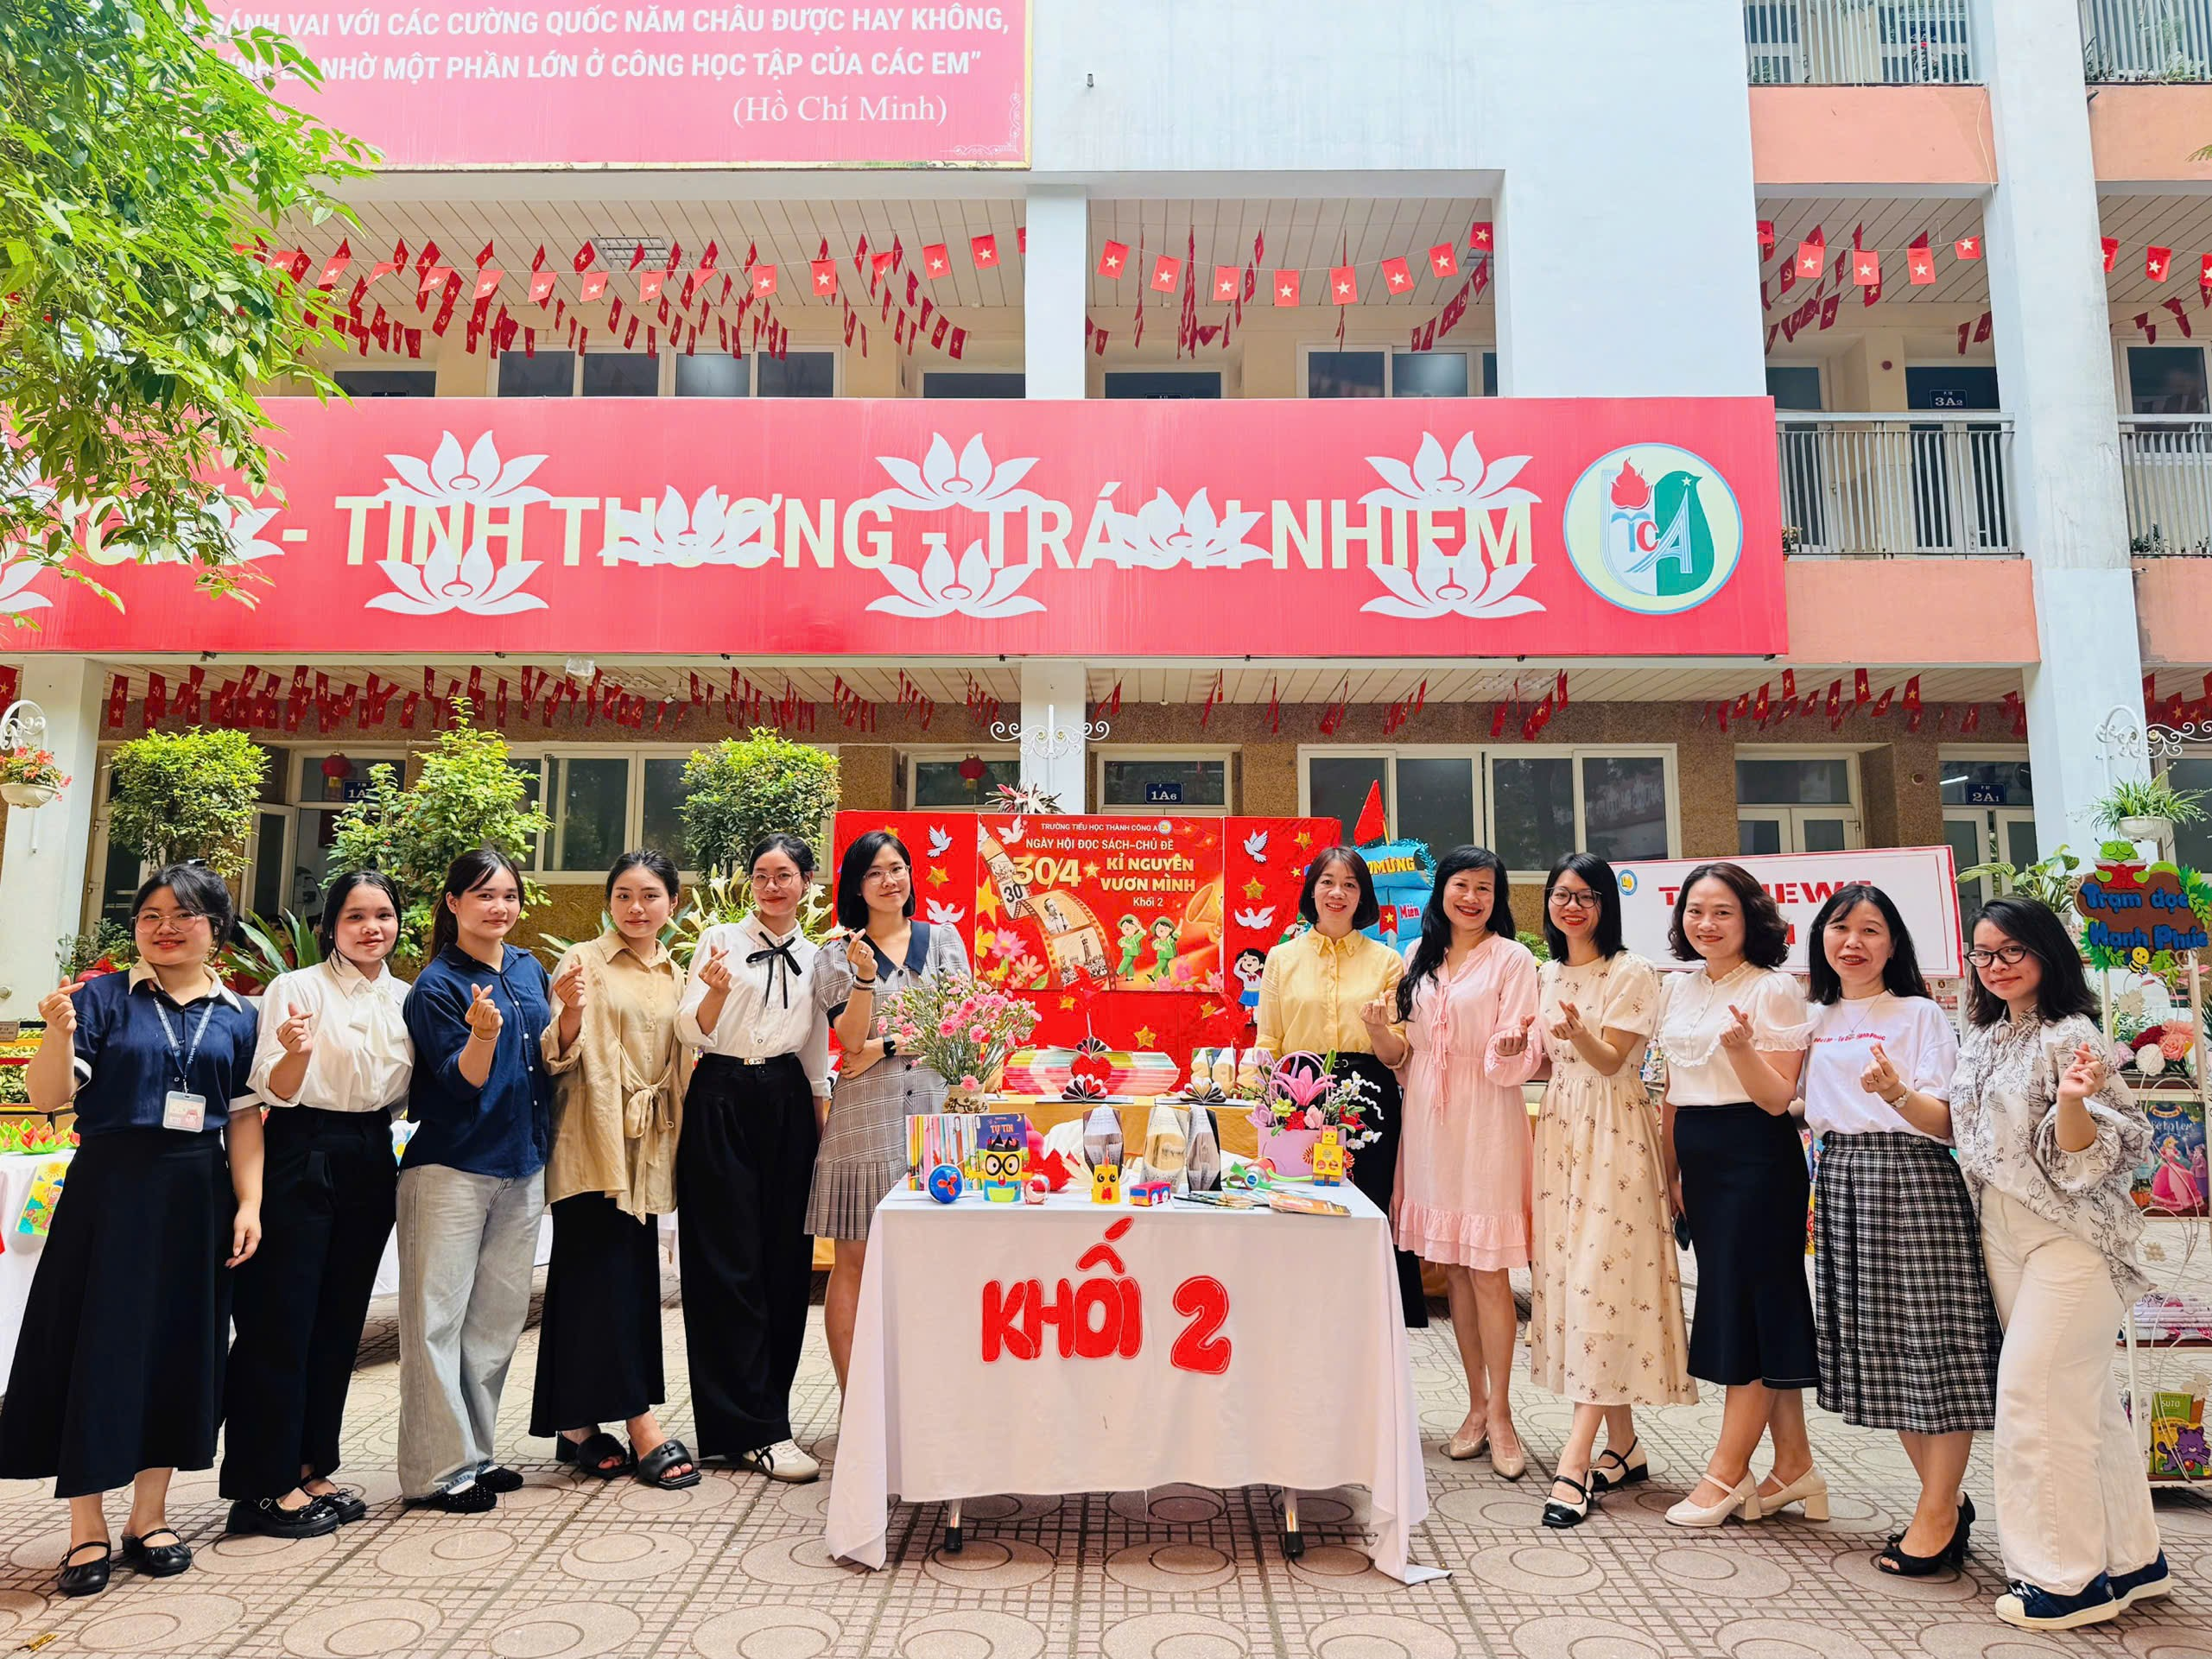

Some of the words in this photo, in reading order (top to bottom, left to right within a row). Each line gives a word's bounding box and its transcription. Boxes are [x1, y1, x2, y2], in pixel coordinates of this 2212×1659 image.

[288, 14, 329, 35] VAI
[338, 8, 379, 35] VỚI
[388, 8, 440, 35] CÁC
[447, 7, 539, 35] CƯỜNG
[546, 4, 618, 36] QUỐC
[624, 5, 685, 33] NĂM
[693, 3, 764, 33] CHÂU
[772, 8, 845, 35] ĐƯỢC
[852, 9, 903, 31] HAY
[911, 3, 1009, 35] KHÔNG,
[320, 52, 376, 80] NHỜ
[383, 52, 440, 85] MỘT
[447, 50, 519, 79] PHẦN
[527, 49, 578, 78] LỚN
[586, 47, 605, 78] Ở
[612, 49, 683, 77] CÔNG
[692, 54, 745, 80] HỌC
[753, 47, 803, 80] TẬP
[811, 46, 864, 75] CỦA
[871, 47, 924, 75] CÁC
[733, 89, 789, 128] (Hồ
[798, 96, 847, 121] Chí
[859, 94, 948, 127] Minh)
[1151, 790, 1178, 801] 1A6
[1041, 822, 1070, 831] TRƯỜNG
[1026, 838, 1054, 849] NGÀY
[1056, 837, 1074, 850] HỘI
[1078, 839, 1099, 851] ĐỌC
[1012, 856, 1082, 890] 30/4
[1106, 852, 1124, 871] KỈ
[1128, 853, 1195, 872] NGUYÊN
[1100, 877, 1151, 893] VƯƠN
[1152, 873, 1195, 892] MÌNH
[1004, 883, 1024, 903] 30
[1133, 896, 1156, 907] Khối
[1157, 898, 1163, 907] 2
[2081, 883, 2143, 915] Trạm
[982, 1216, 1143, 1363] KHỐI
[1170, 1276, 1232, 1375] 2
